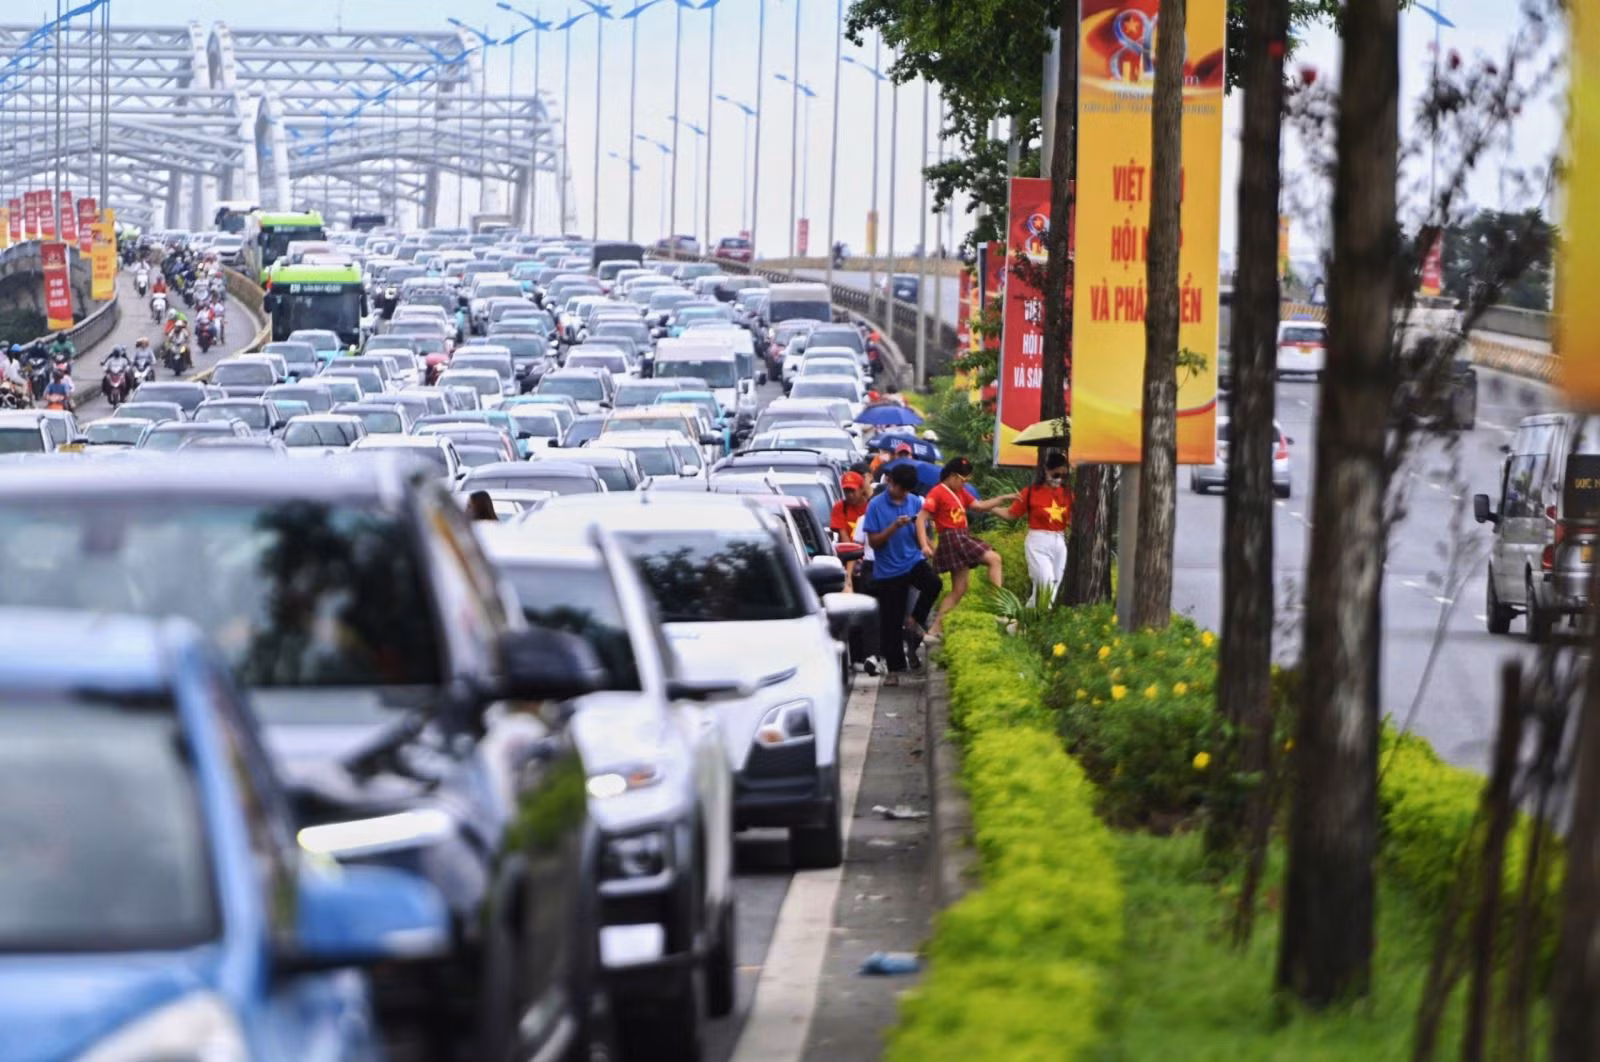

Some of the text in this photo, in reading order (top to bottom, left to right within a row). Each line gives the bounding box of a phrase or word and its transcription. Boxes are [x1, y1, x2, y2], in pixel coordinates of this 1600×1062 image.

[1113, 157, 1145, 210] VIỆT
[1111, 217, 1136, 270] HỘI
[1091, 277, 1109, 321] VÀ
[1115, 277, 1146, 323] PHÁ
[1023, 329, 1038, 359] HỘI
[1014, 362, 1025, 388] VÀ
[1027, 363, 1043, 388] SÁ
